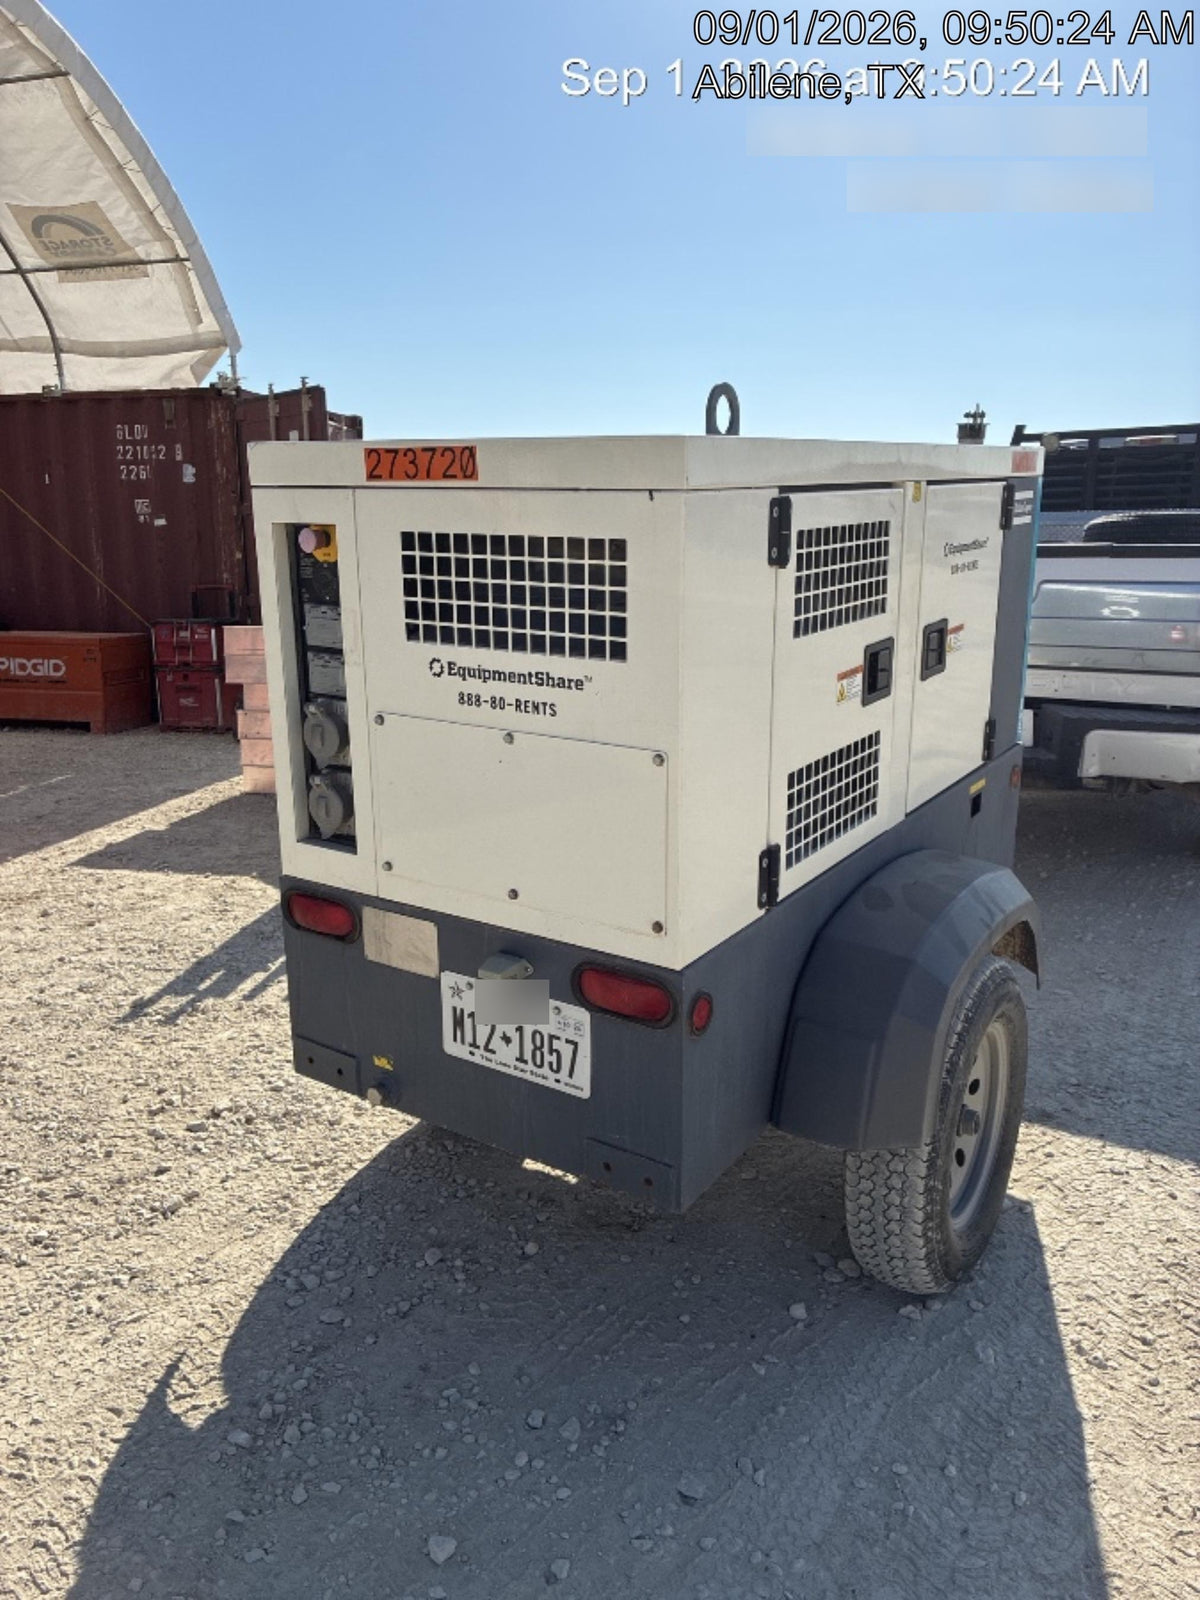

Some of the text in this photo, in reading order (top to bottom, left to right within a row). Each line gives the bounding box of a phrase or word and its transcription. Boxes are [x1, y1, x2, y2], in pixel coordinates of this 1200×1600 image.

[367, 445, 477, 479] 273720
[458, 691, 558, 717] 888-80-RENTS
[515, 1025, 579, 1080] 1857
